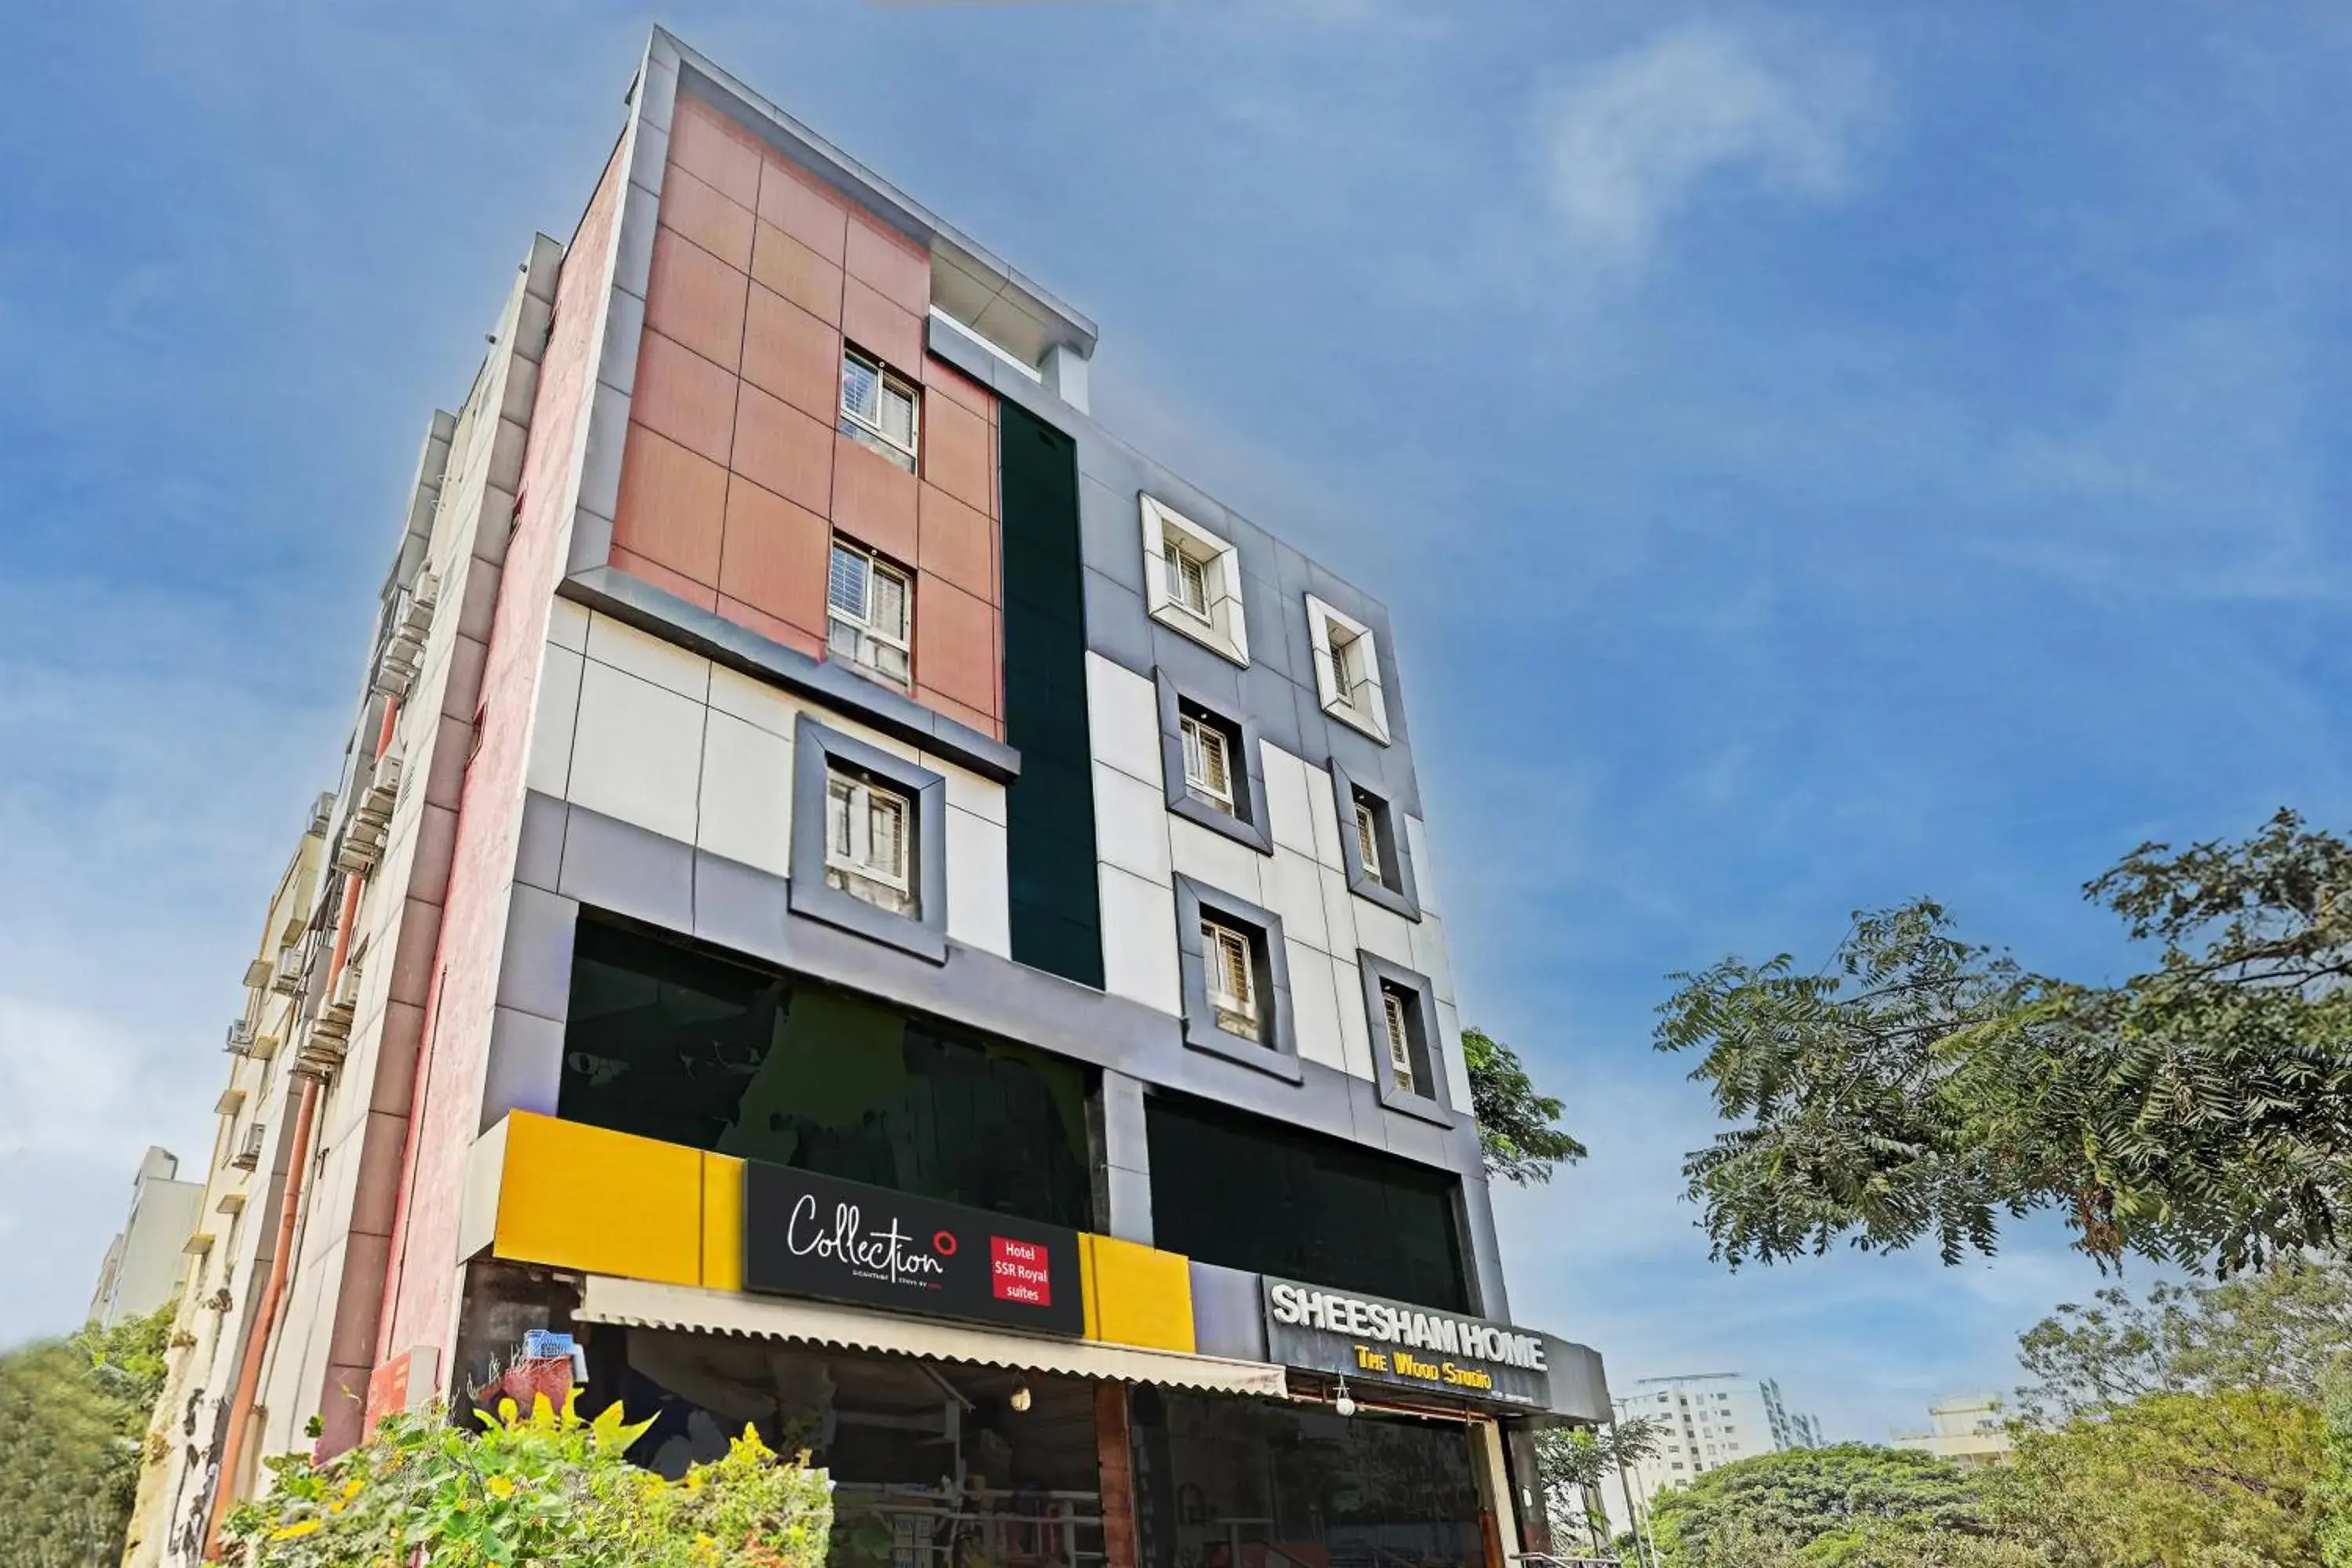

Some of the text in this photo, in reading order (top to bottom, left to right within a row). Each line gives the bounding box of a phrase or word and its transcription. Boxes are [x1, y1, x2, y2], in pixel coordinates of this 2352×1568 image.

[787, 1194, 943, 1283] Collection
[1005, 1242, 1035, 1261] Hotel
[995, 1260, 1048, 1284] SSR Royal
[1007, 1285, 1039, 1301] suites
